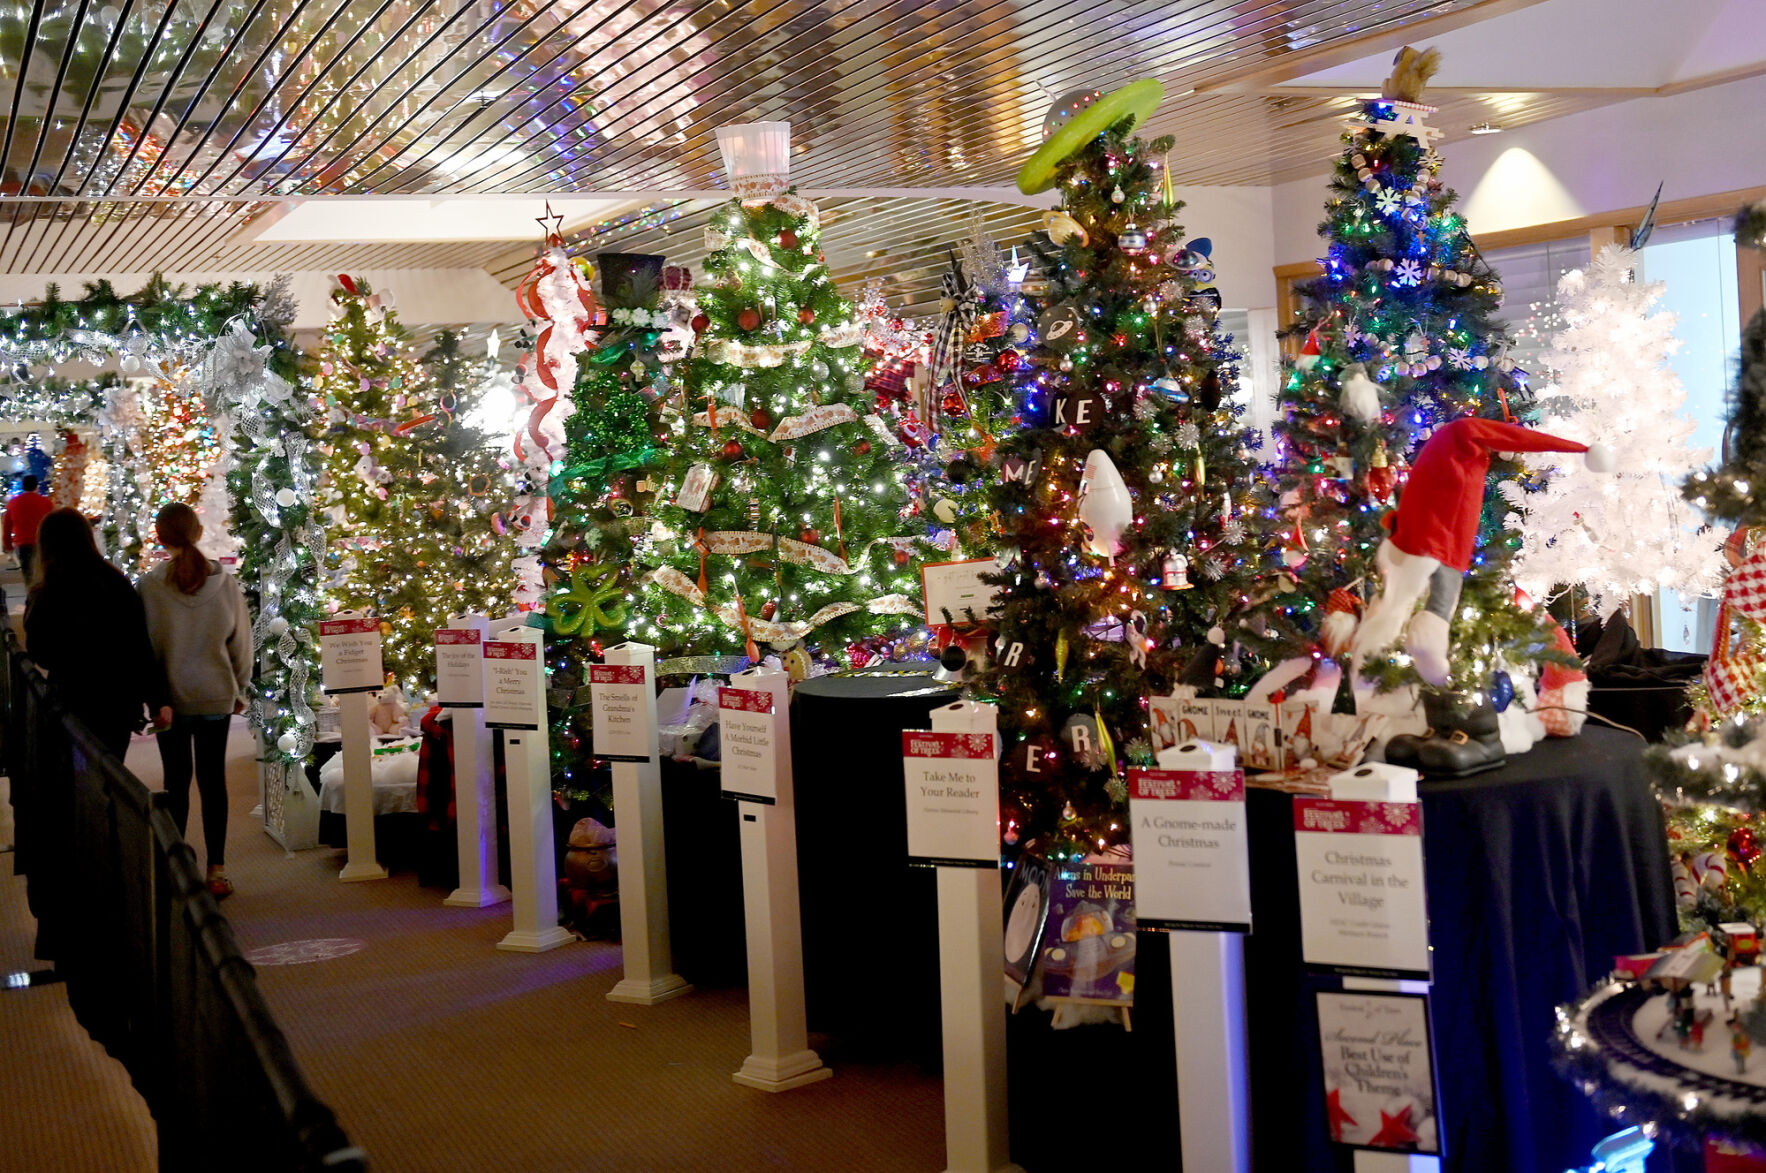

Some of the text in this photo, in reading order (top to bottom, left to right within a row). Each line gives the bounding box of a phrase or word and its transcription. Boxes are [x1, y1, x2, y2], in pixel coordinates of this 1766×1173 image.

[515, 667, 528, 676] You
[599, 692, 610, 701] The
[608, 714, 632, 723] Kitchen
[725, 719, 768, 734] Have Yourself
[731, 734, 753, 745] Morbid
[731, 745, 762, 759] Christmas
[922, 771, 976, 784] Take Me to
[919, 786, 980, 799] Your Reader
[1141, 816, 1237, 832] A Gnome-made
[1158, 834, 1220, 848] Christmas
[1324, 850, 1393, 867] Christmas
[1083, 868, 1093, 881] in
[1311, 870, 1409, 890] Carnival in the
[1065, 883, 1132, 900] Save the World
[1337, 890, 1385, 910] Village
[1340, 1045, 1411, 1065] Best Use of
[1344, 1062, 1408, 1080] Children's
[1357, 1079, 1401, 1097] Theme
